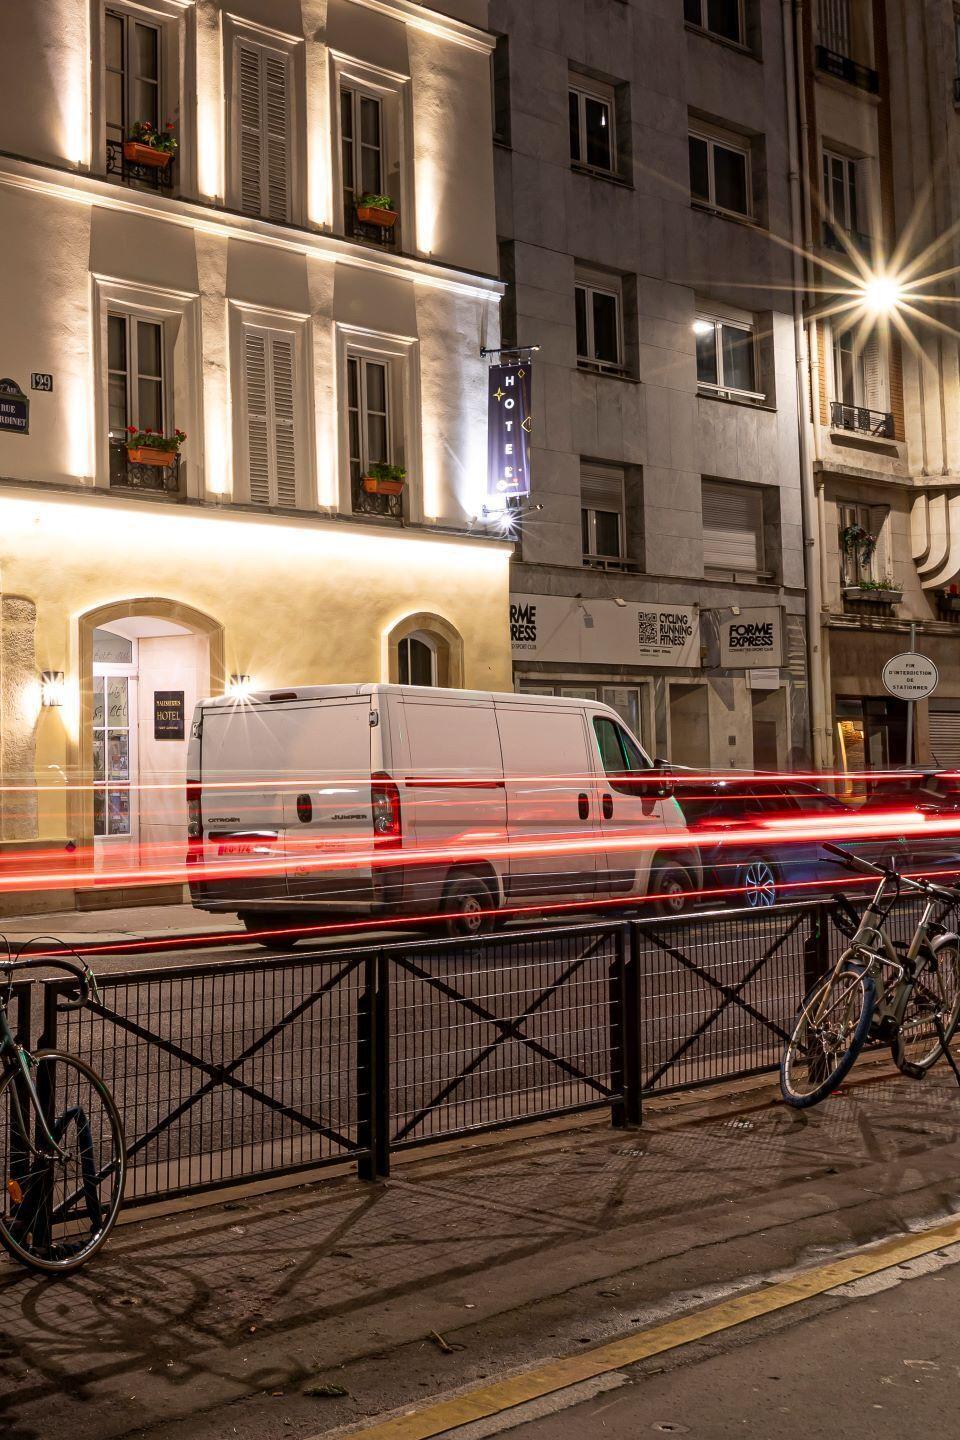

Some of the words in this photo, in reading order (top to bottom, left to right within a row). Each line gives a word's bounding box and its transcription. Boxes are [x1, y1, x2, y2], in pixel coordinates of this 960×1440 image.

[31, 373, 52, 391] 129
[0, 403, 16, 414] RUE
[504, 375, 515, 478] HOTEL
[510, 602, 537, 624] RME
[659, 613, 688, 625] CYCLING
[510, 624, 537, 641] RESS
[659, 623, 693, 636] RUNNING
[729, 622, 774, 636] FORME
[659, 634, 686, 646] FITNESS
[729, 635, 774, 647] EXPRESS
[156, 710, 181, 721] HOTEL
